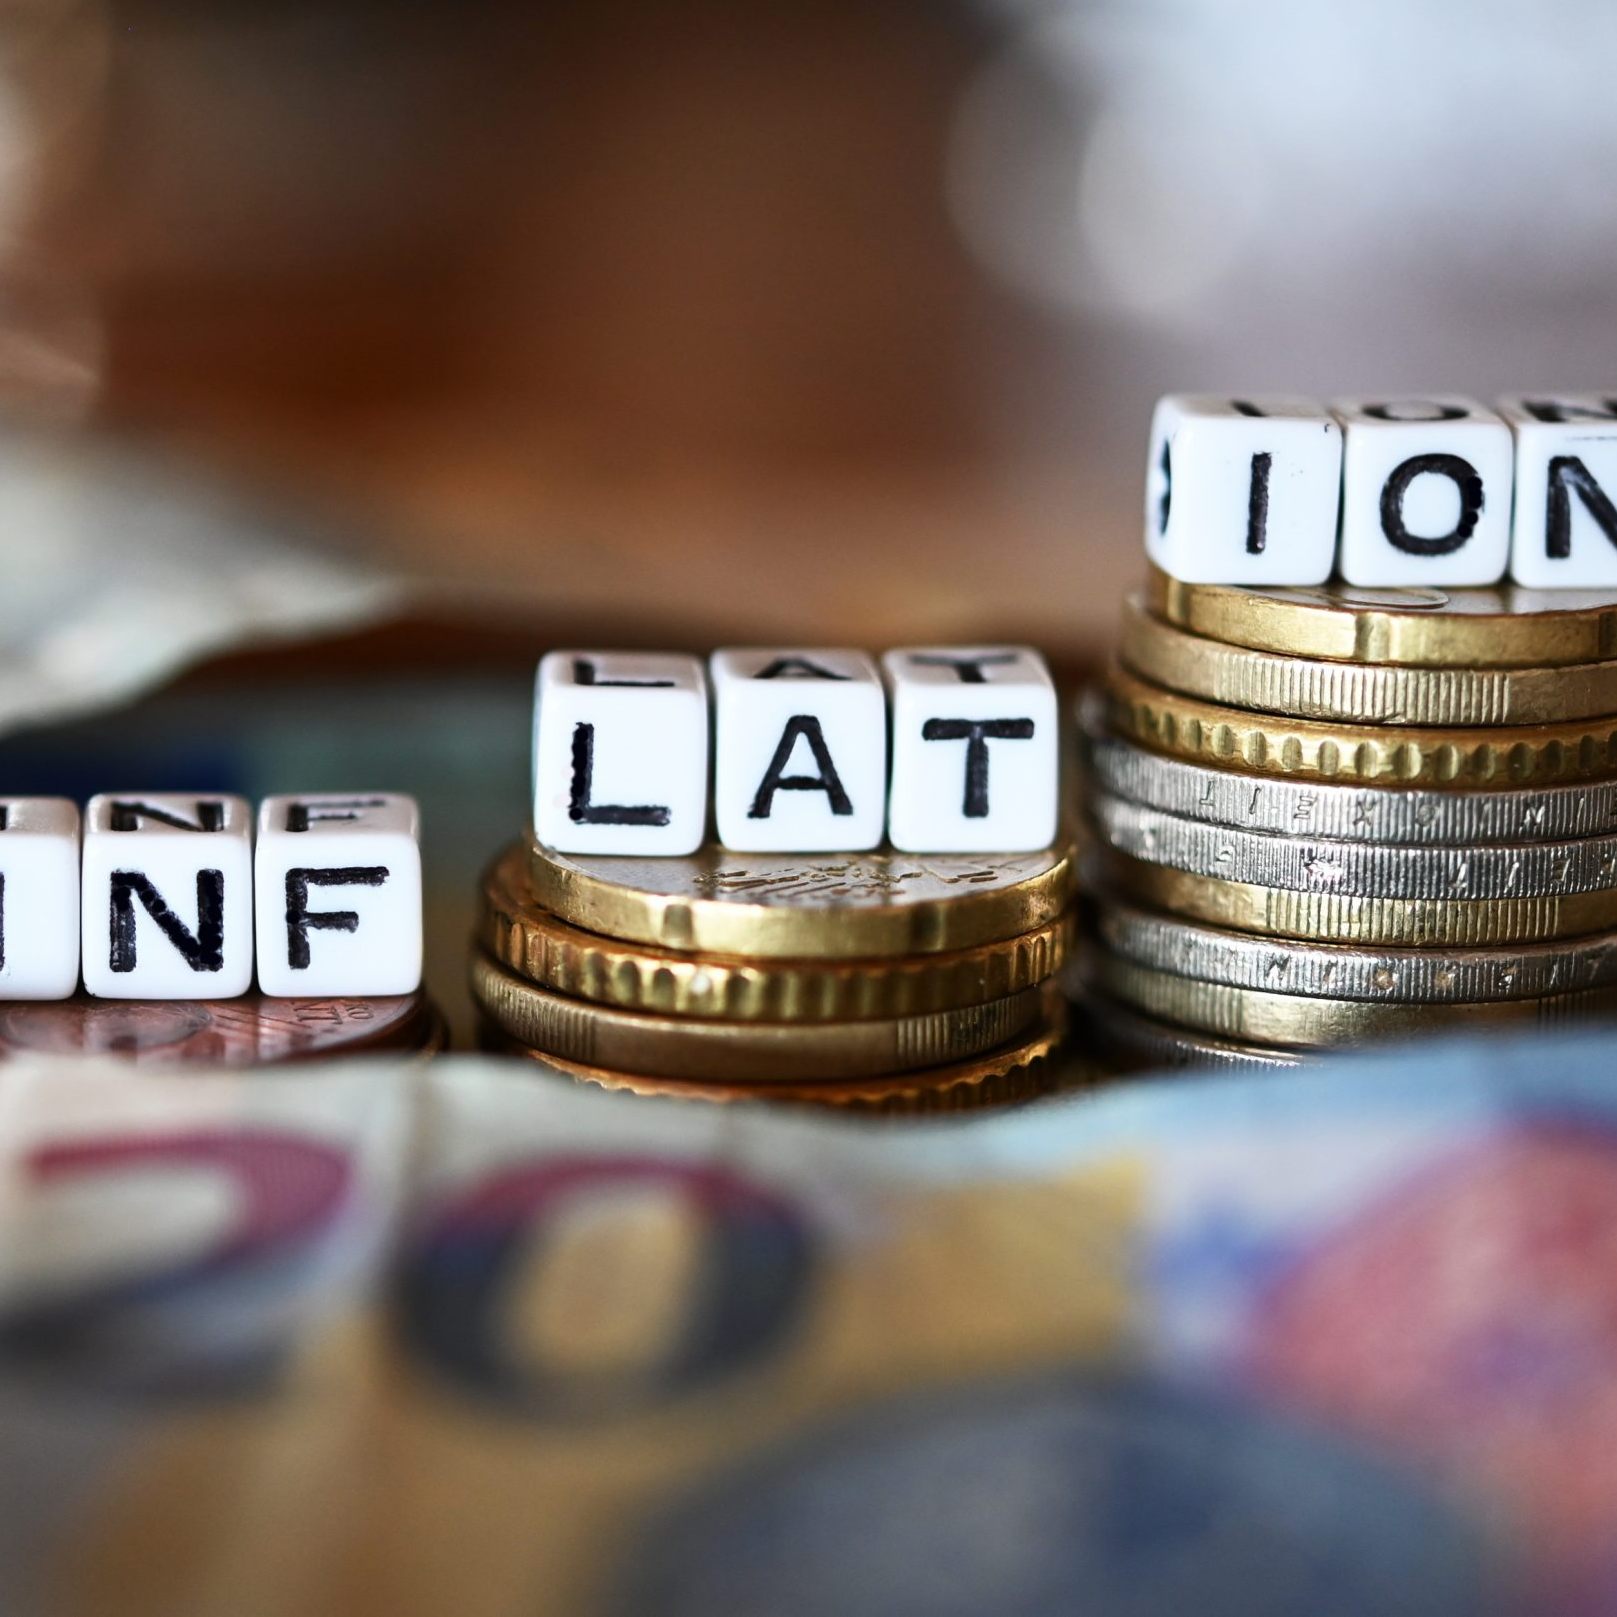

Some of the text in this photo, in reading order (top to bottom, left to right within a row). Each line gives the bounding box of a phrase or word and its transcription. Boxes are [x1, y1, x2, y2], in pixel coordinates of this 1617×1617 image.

[0, 798, 386, 832] NF
[568, 714, 1034, 826] LAT
[0, 865, 390, 973] NF
